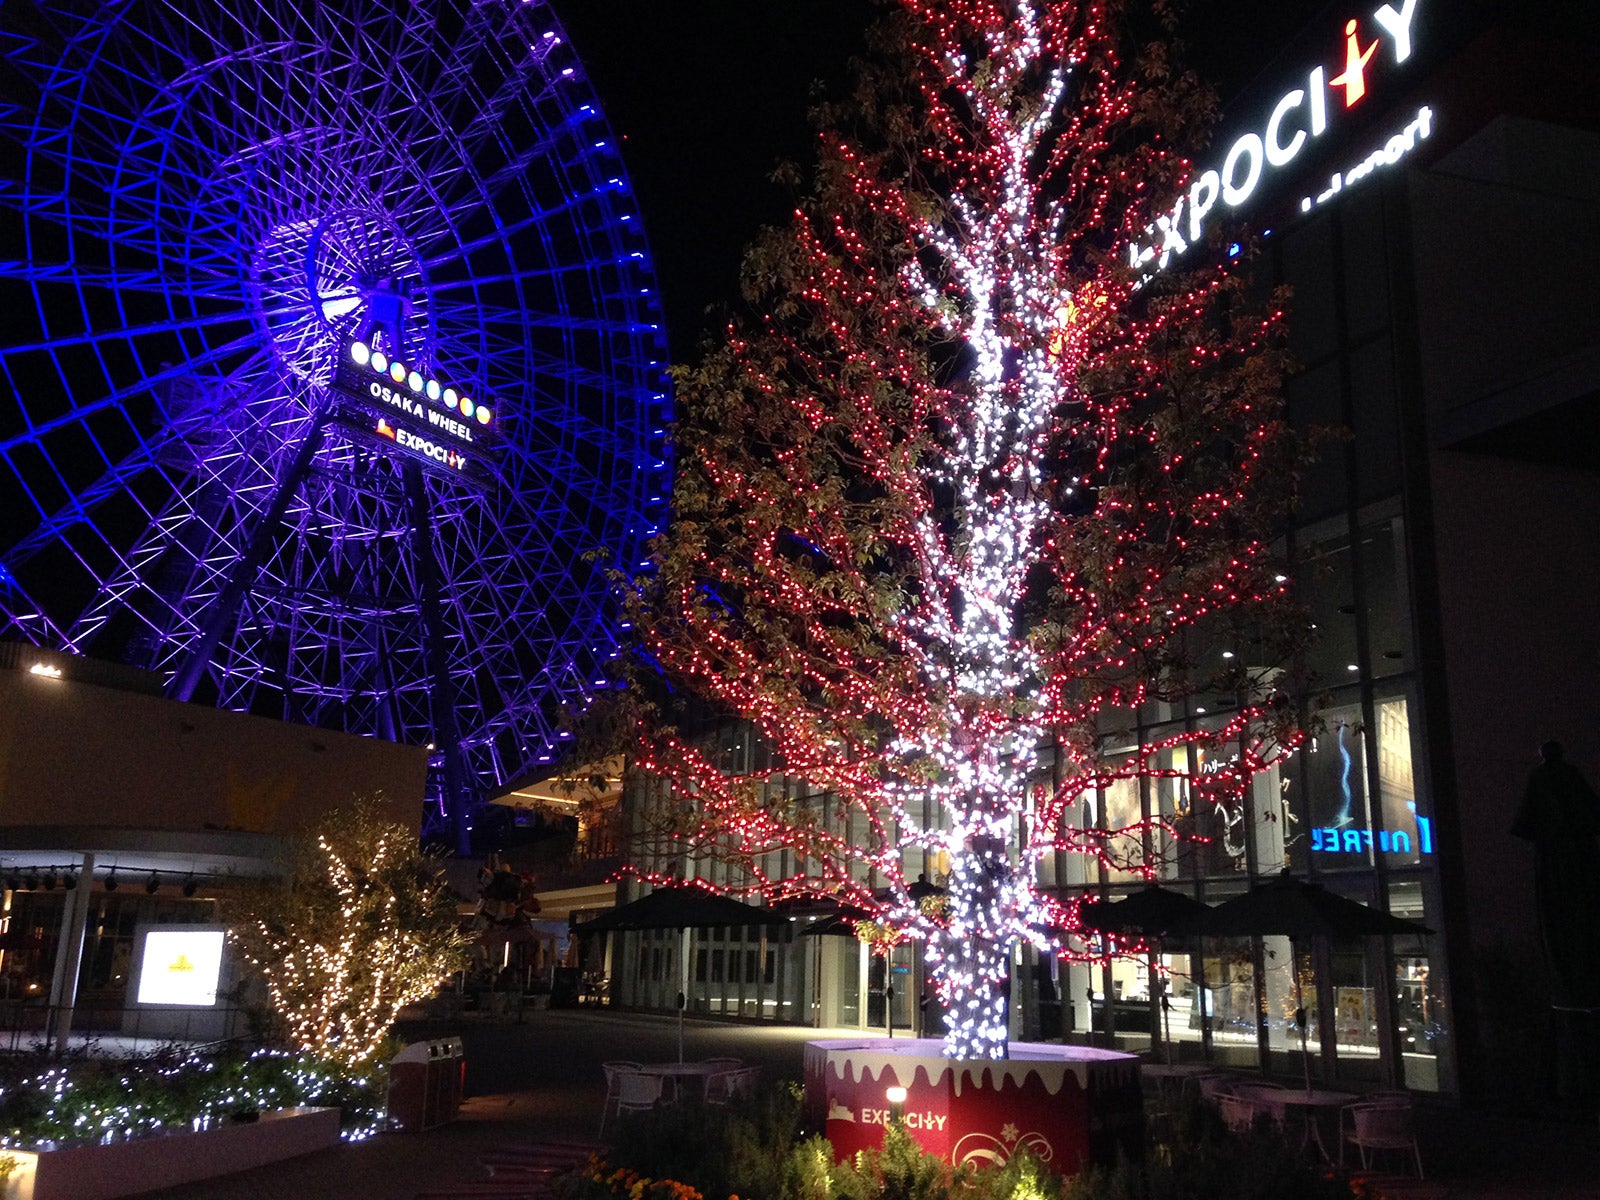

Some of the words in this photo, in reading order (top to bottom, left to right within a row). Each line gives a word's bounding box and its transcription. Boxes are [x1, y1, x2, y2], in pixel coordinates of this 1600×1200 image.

[369, 382, 424, 418] OSAKA
[427, 409, 474, 442] WHEEL
[395, 428, 466, 470] EXPOCITY
[861, 1107, 947, 1132] EXPCITY
